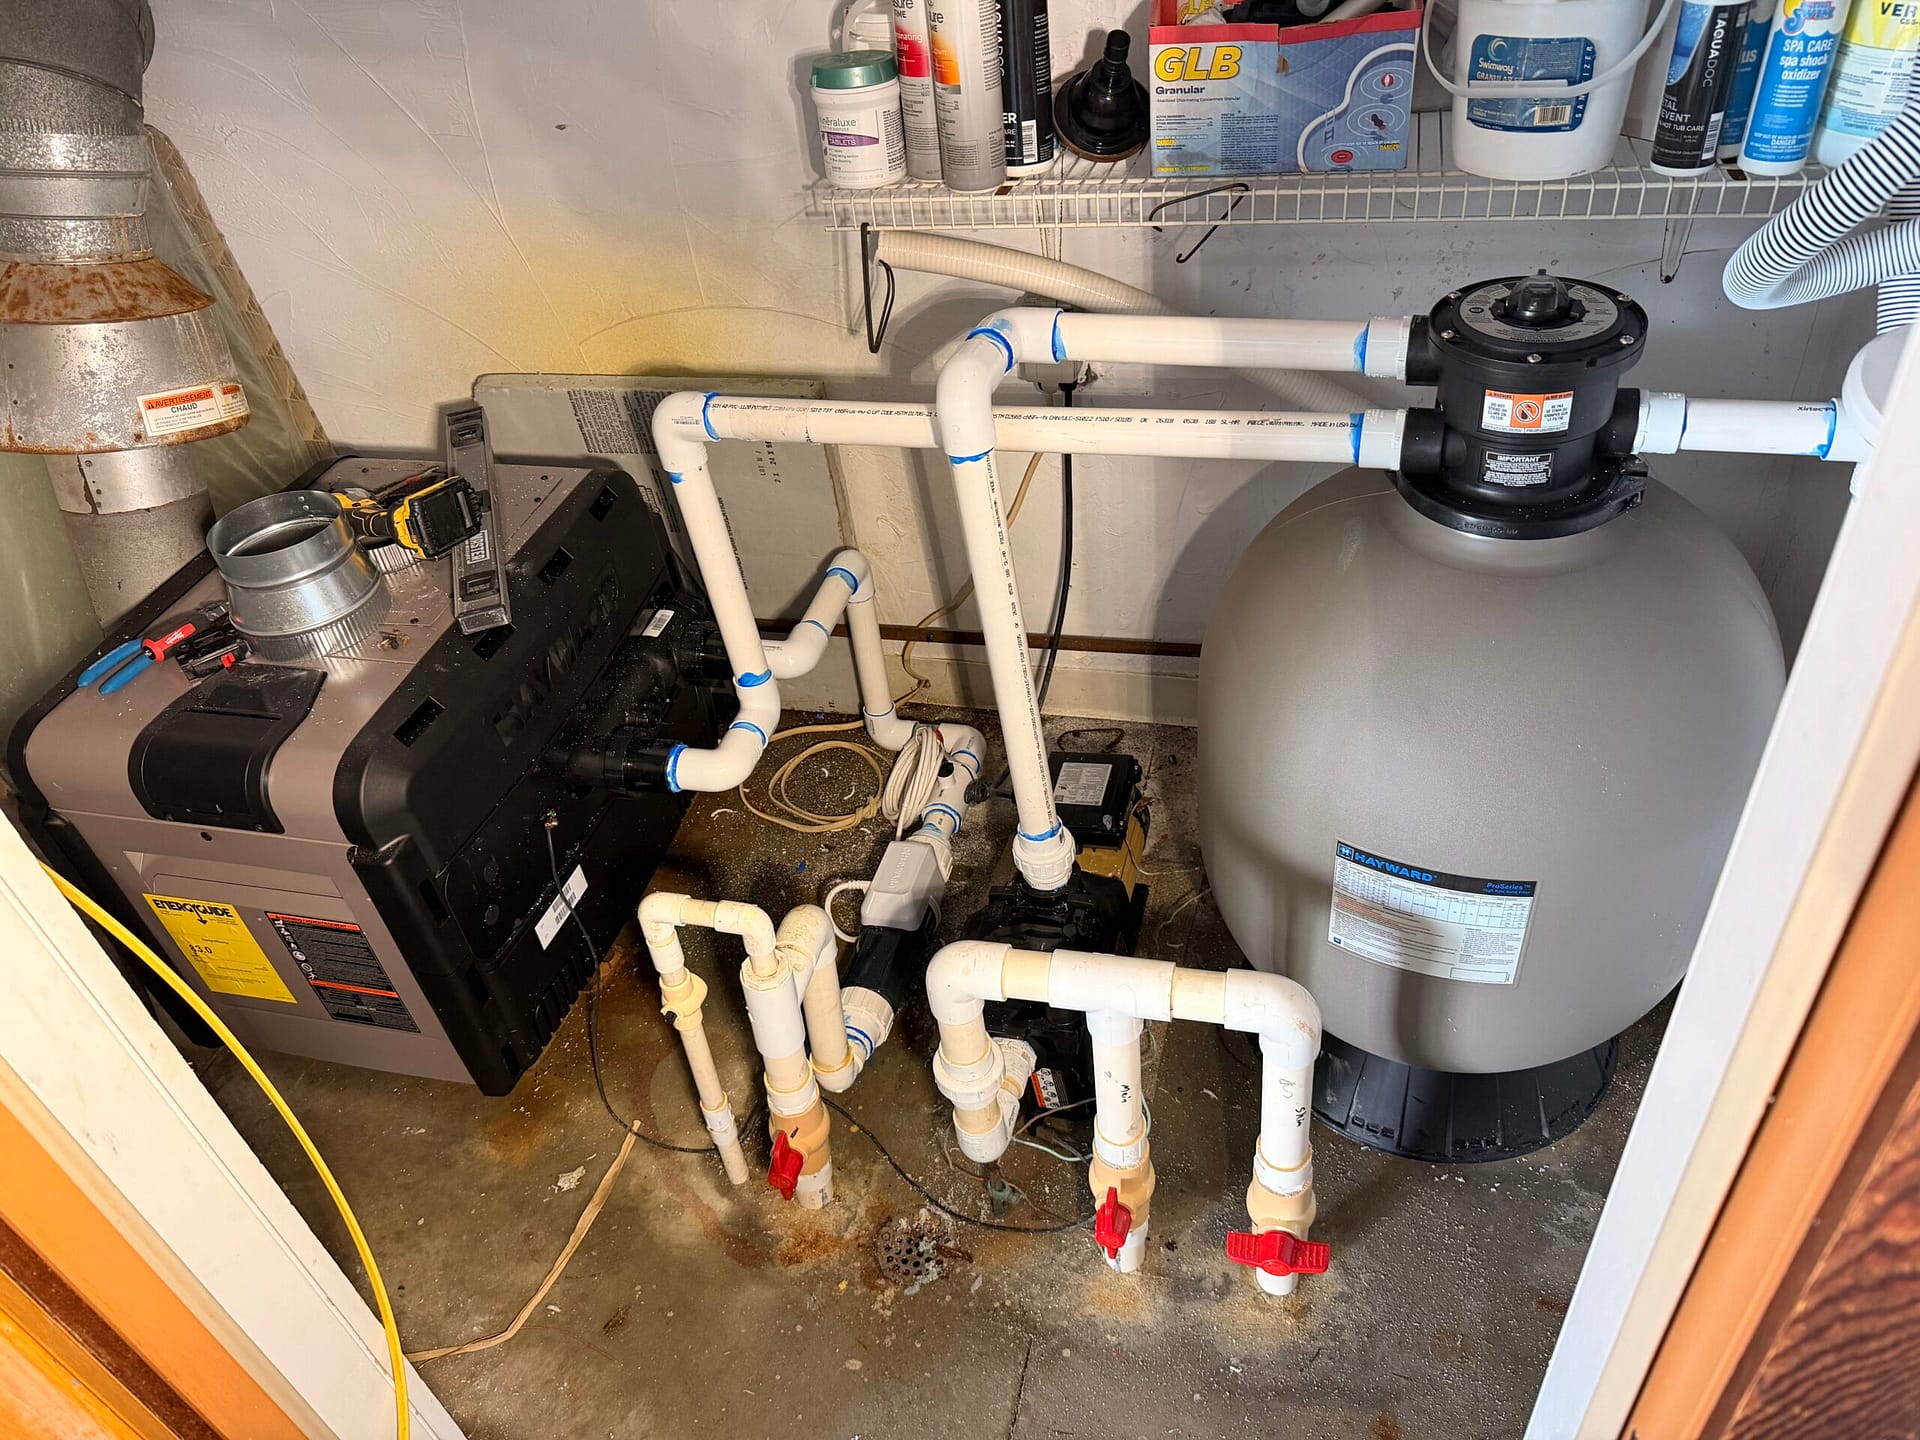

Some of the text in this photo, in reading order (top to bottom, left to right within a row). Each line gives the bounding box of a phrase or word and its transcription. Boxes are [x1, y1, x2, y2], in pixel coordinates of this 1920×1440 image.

[1881, 3, 1918, 17] VER
[1702, 19, 1727, 87] AQUADOC
[1783, 38, 1835, 53] SPA CARE
[1154, 46, 1242, 83] GLB
[1478, 57, 1514, 75] Swimway
[1779, 53, 1828, 69] spa shock
[1781, 68, 1821, 81] oxidizer
[1155, 86, 1206, 96] Granular
[1003, 112, 1017, 124] ER
[1661, 110, 1691, 123] EVENT
[156, 390, 211, 407] AVERTISSEMENT
[170, 402, 198, 414] CHAUD
[1354, 852, 1433, 882] HAYWARD
